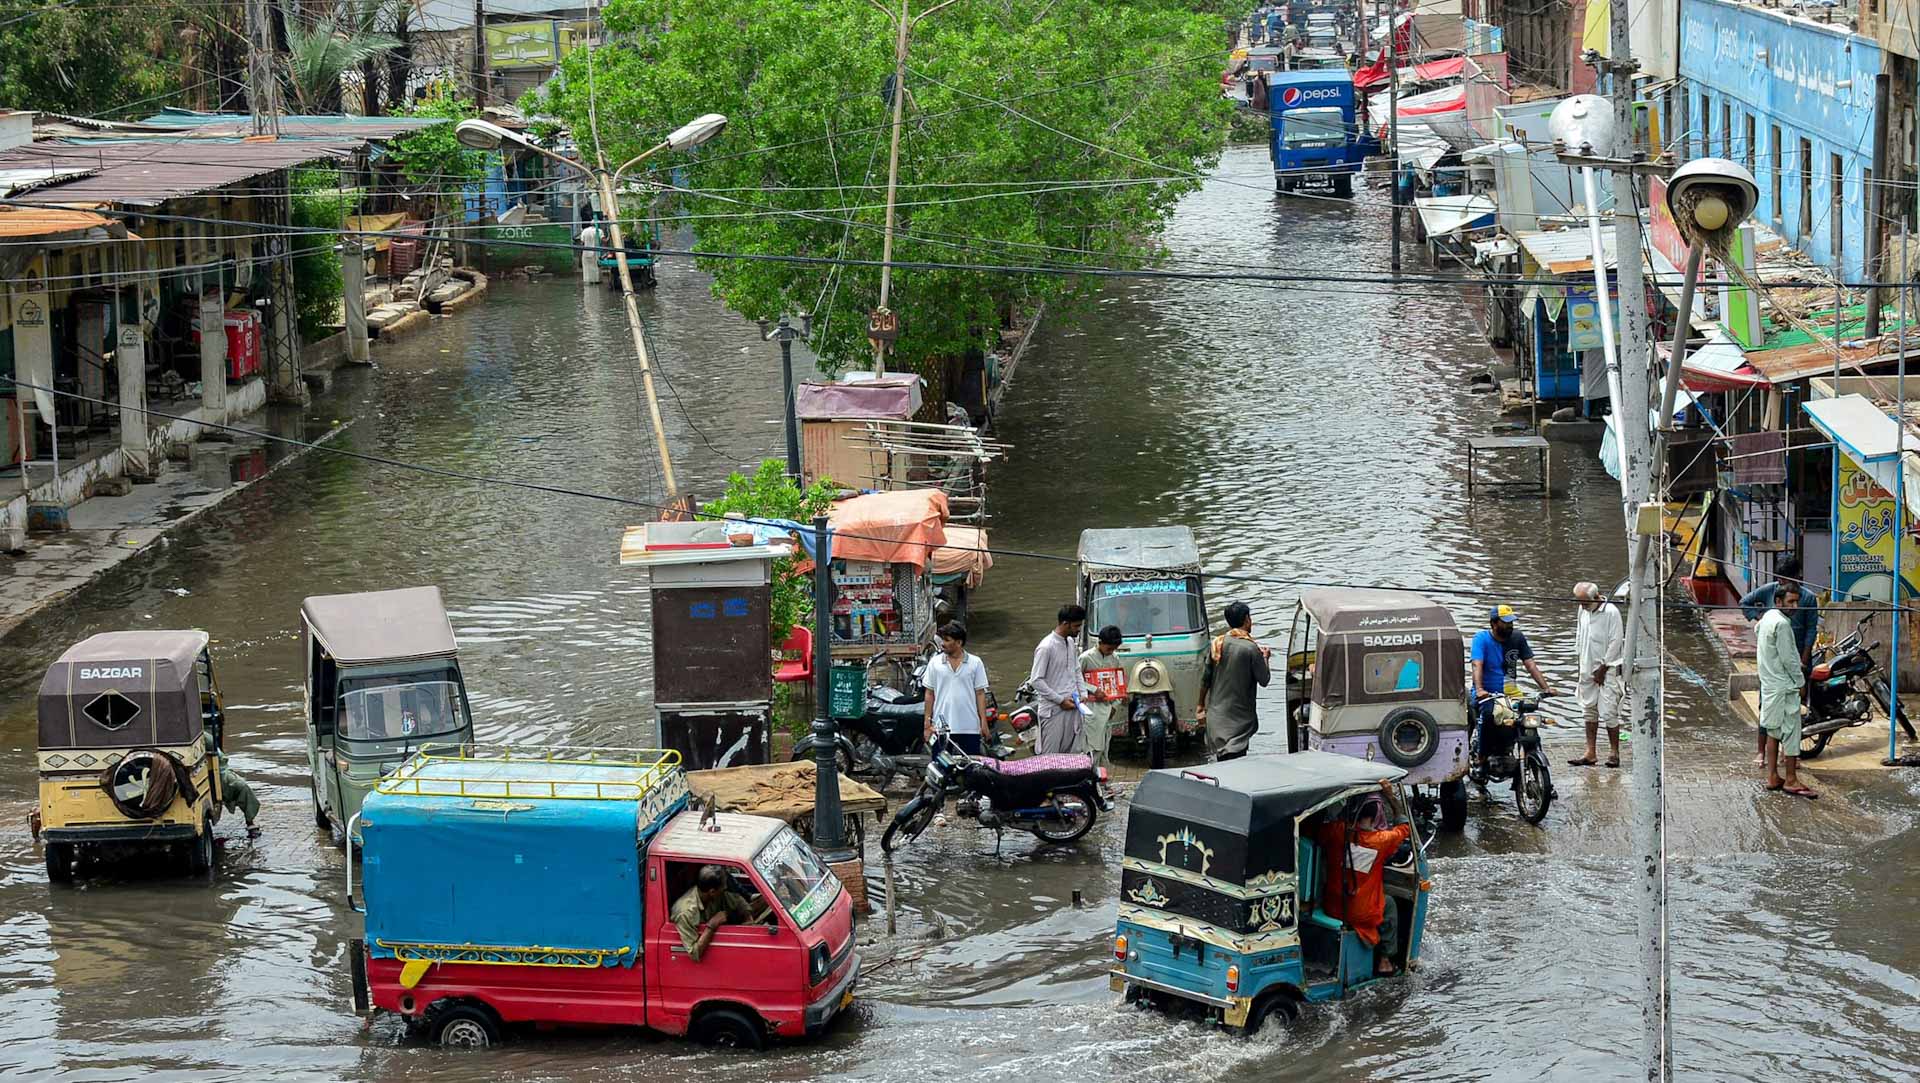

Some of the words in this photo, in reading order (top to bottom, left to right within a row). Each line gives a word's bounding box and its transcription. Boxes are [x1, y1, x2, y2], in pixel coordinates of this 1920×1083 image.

[1302, 86, 1340, 102] pepsi
[1363, 634, 1423, 647] SAZGAR
[80, 666, 142, 680] SAZGAR
